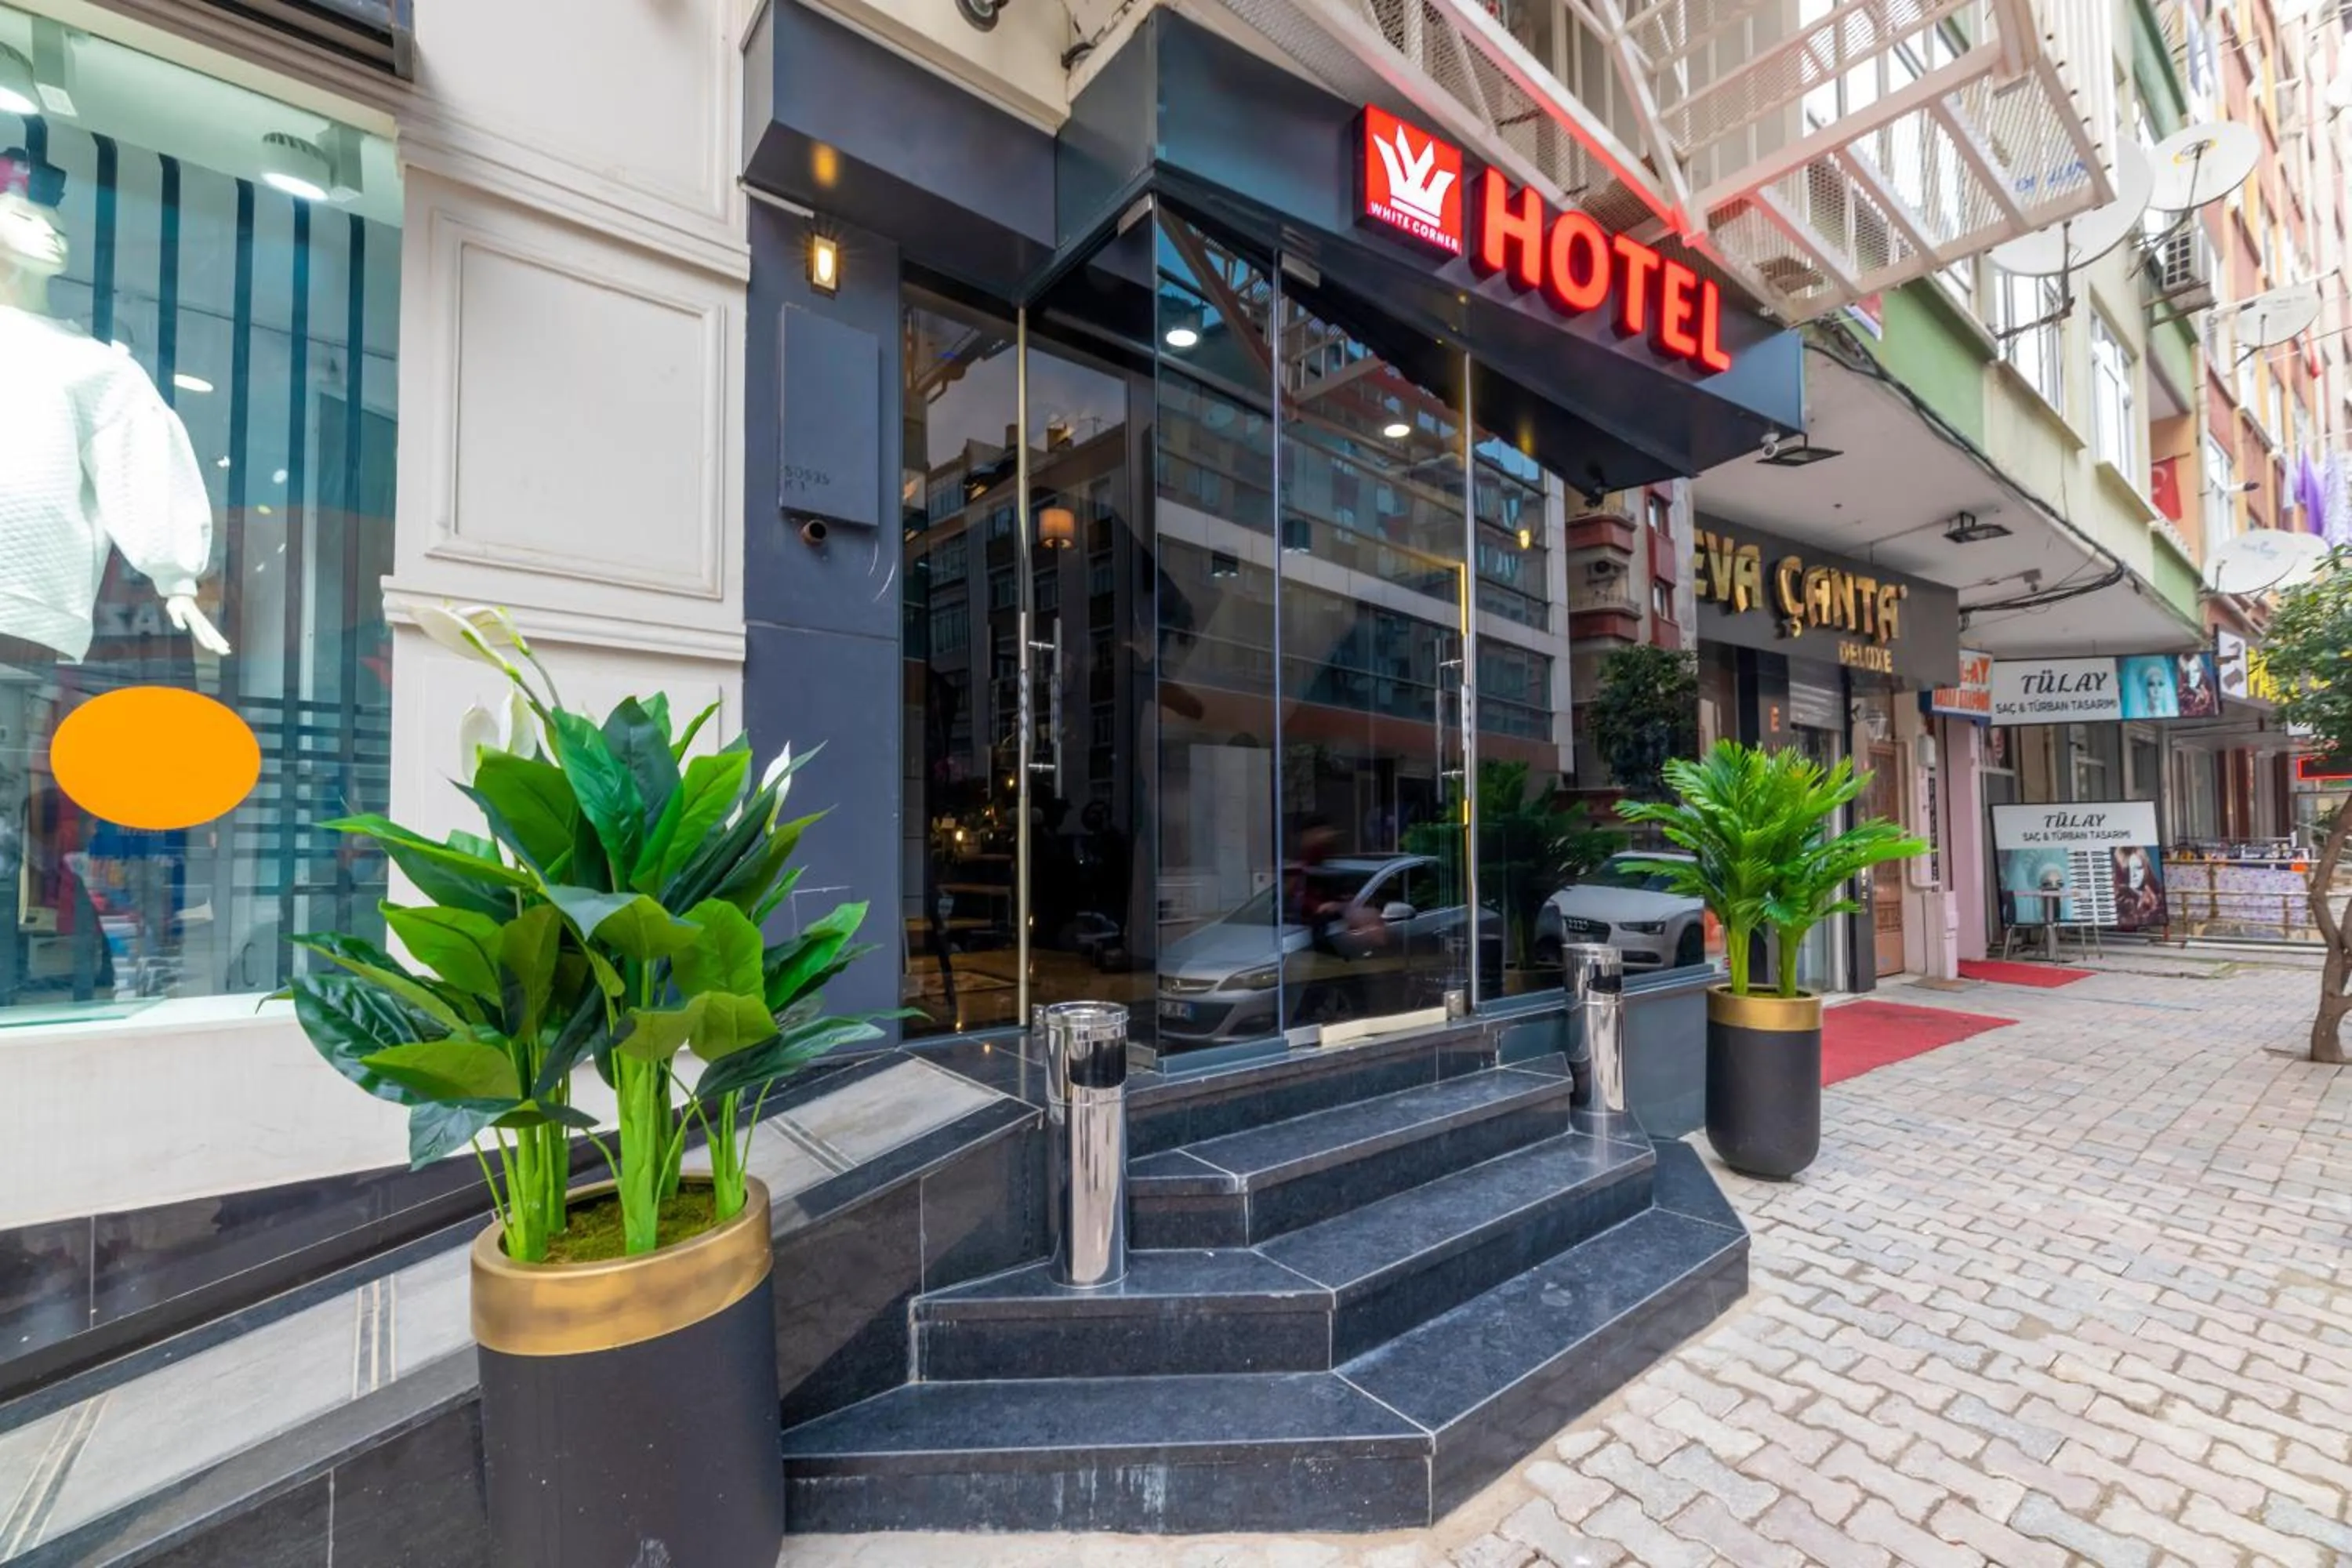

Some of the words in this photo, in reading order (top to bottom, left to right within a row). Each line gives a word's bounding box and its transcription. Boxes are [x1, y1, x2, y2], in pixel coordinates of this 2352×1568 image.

[1370, 201, 1410, 230] WHITE
[1412, 220, 1459, 252] CORNER
[1482, 165, 1732, 374] HOTEL
[1693, 528, 1762, 613] EVA
[1774, 555, 1901, 645] ÇANTA
[1838, 640, 1893, 673] DELUXE
[2020, 669, 2107, 695] TÜLAY
[2043, 811, 2106, 828] TÜLAY
